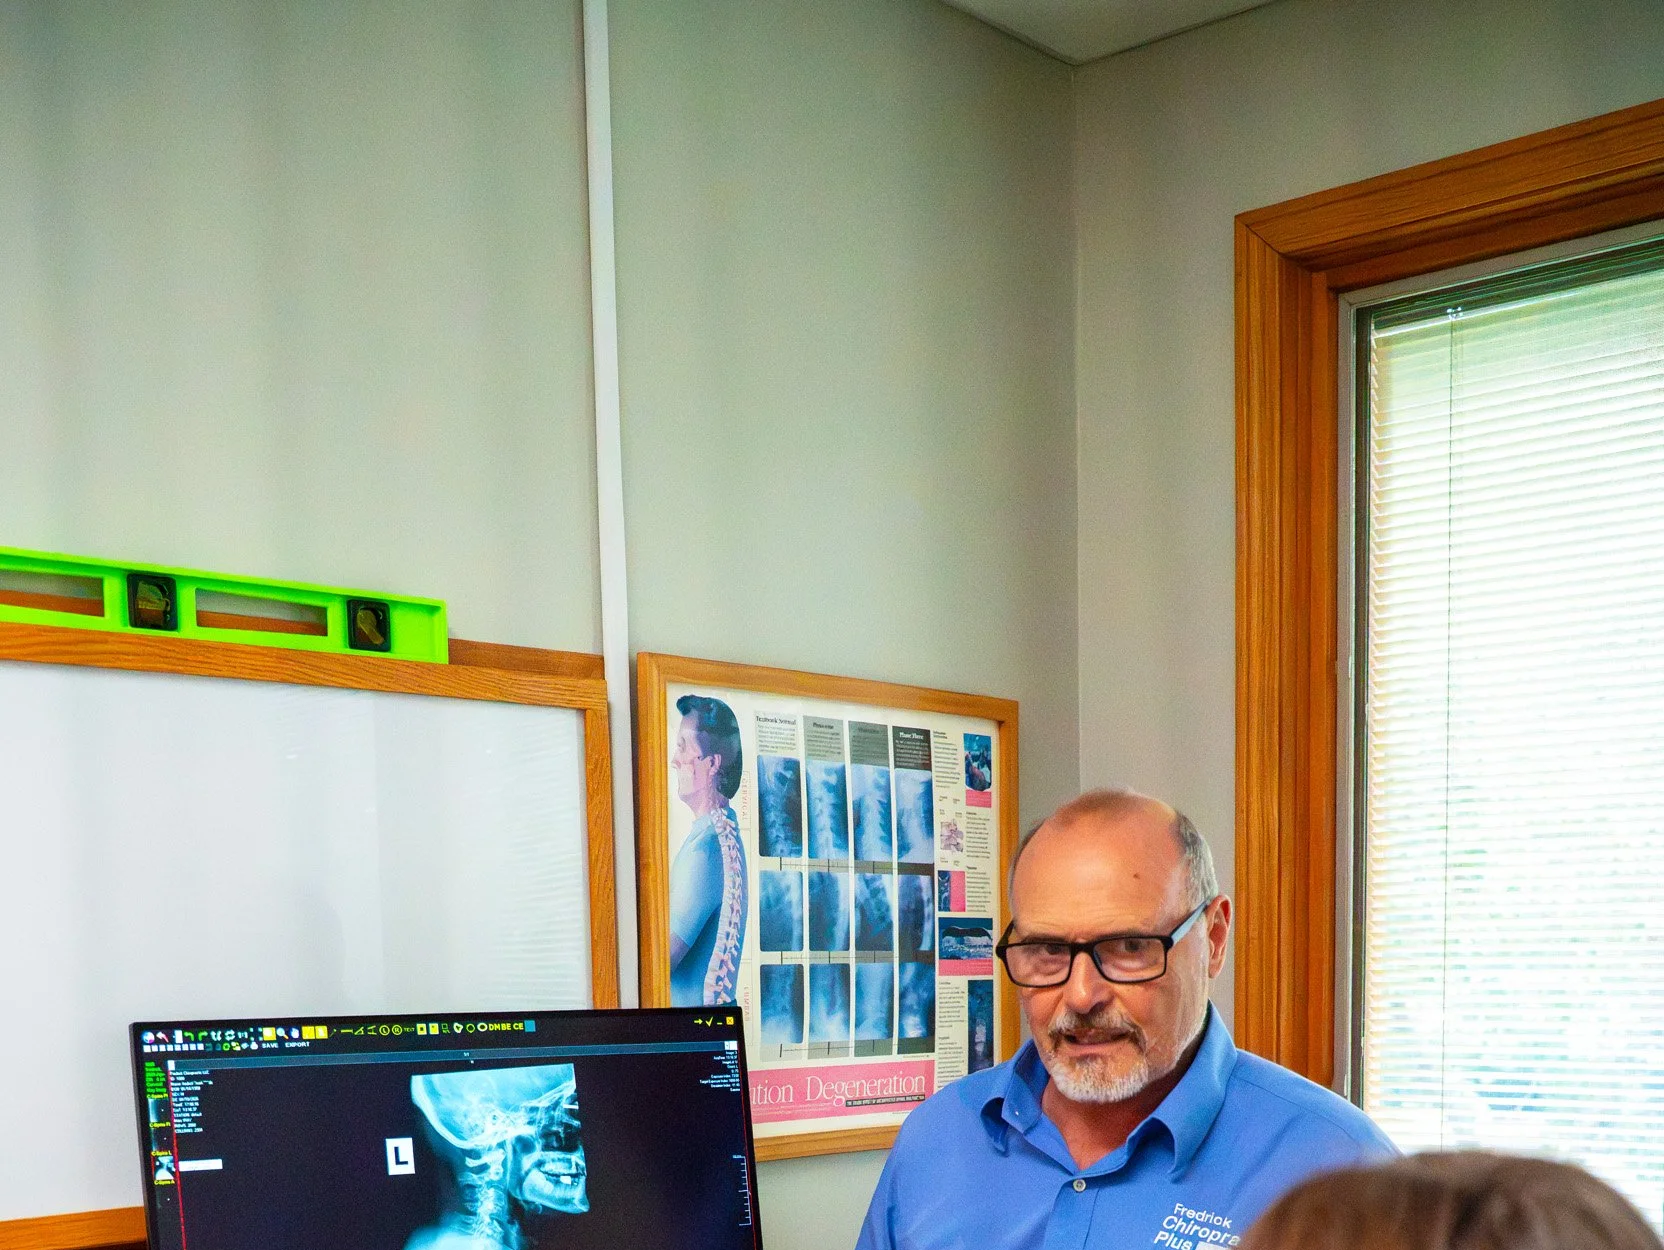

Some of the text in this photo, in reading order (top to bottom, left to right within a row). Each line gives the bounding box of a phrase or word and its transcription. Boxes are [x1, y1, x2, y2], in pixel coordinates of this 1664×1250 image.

[806, 1071, 925, 1107] Degeneration
[394, 1146, 408, 1166] L
[1173, 1202, 1233, 1229] Fredrick
